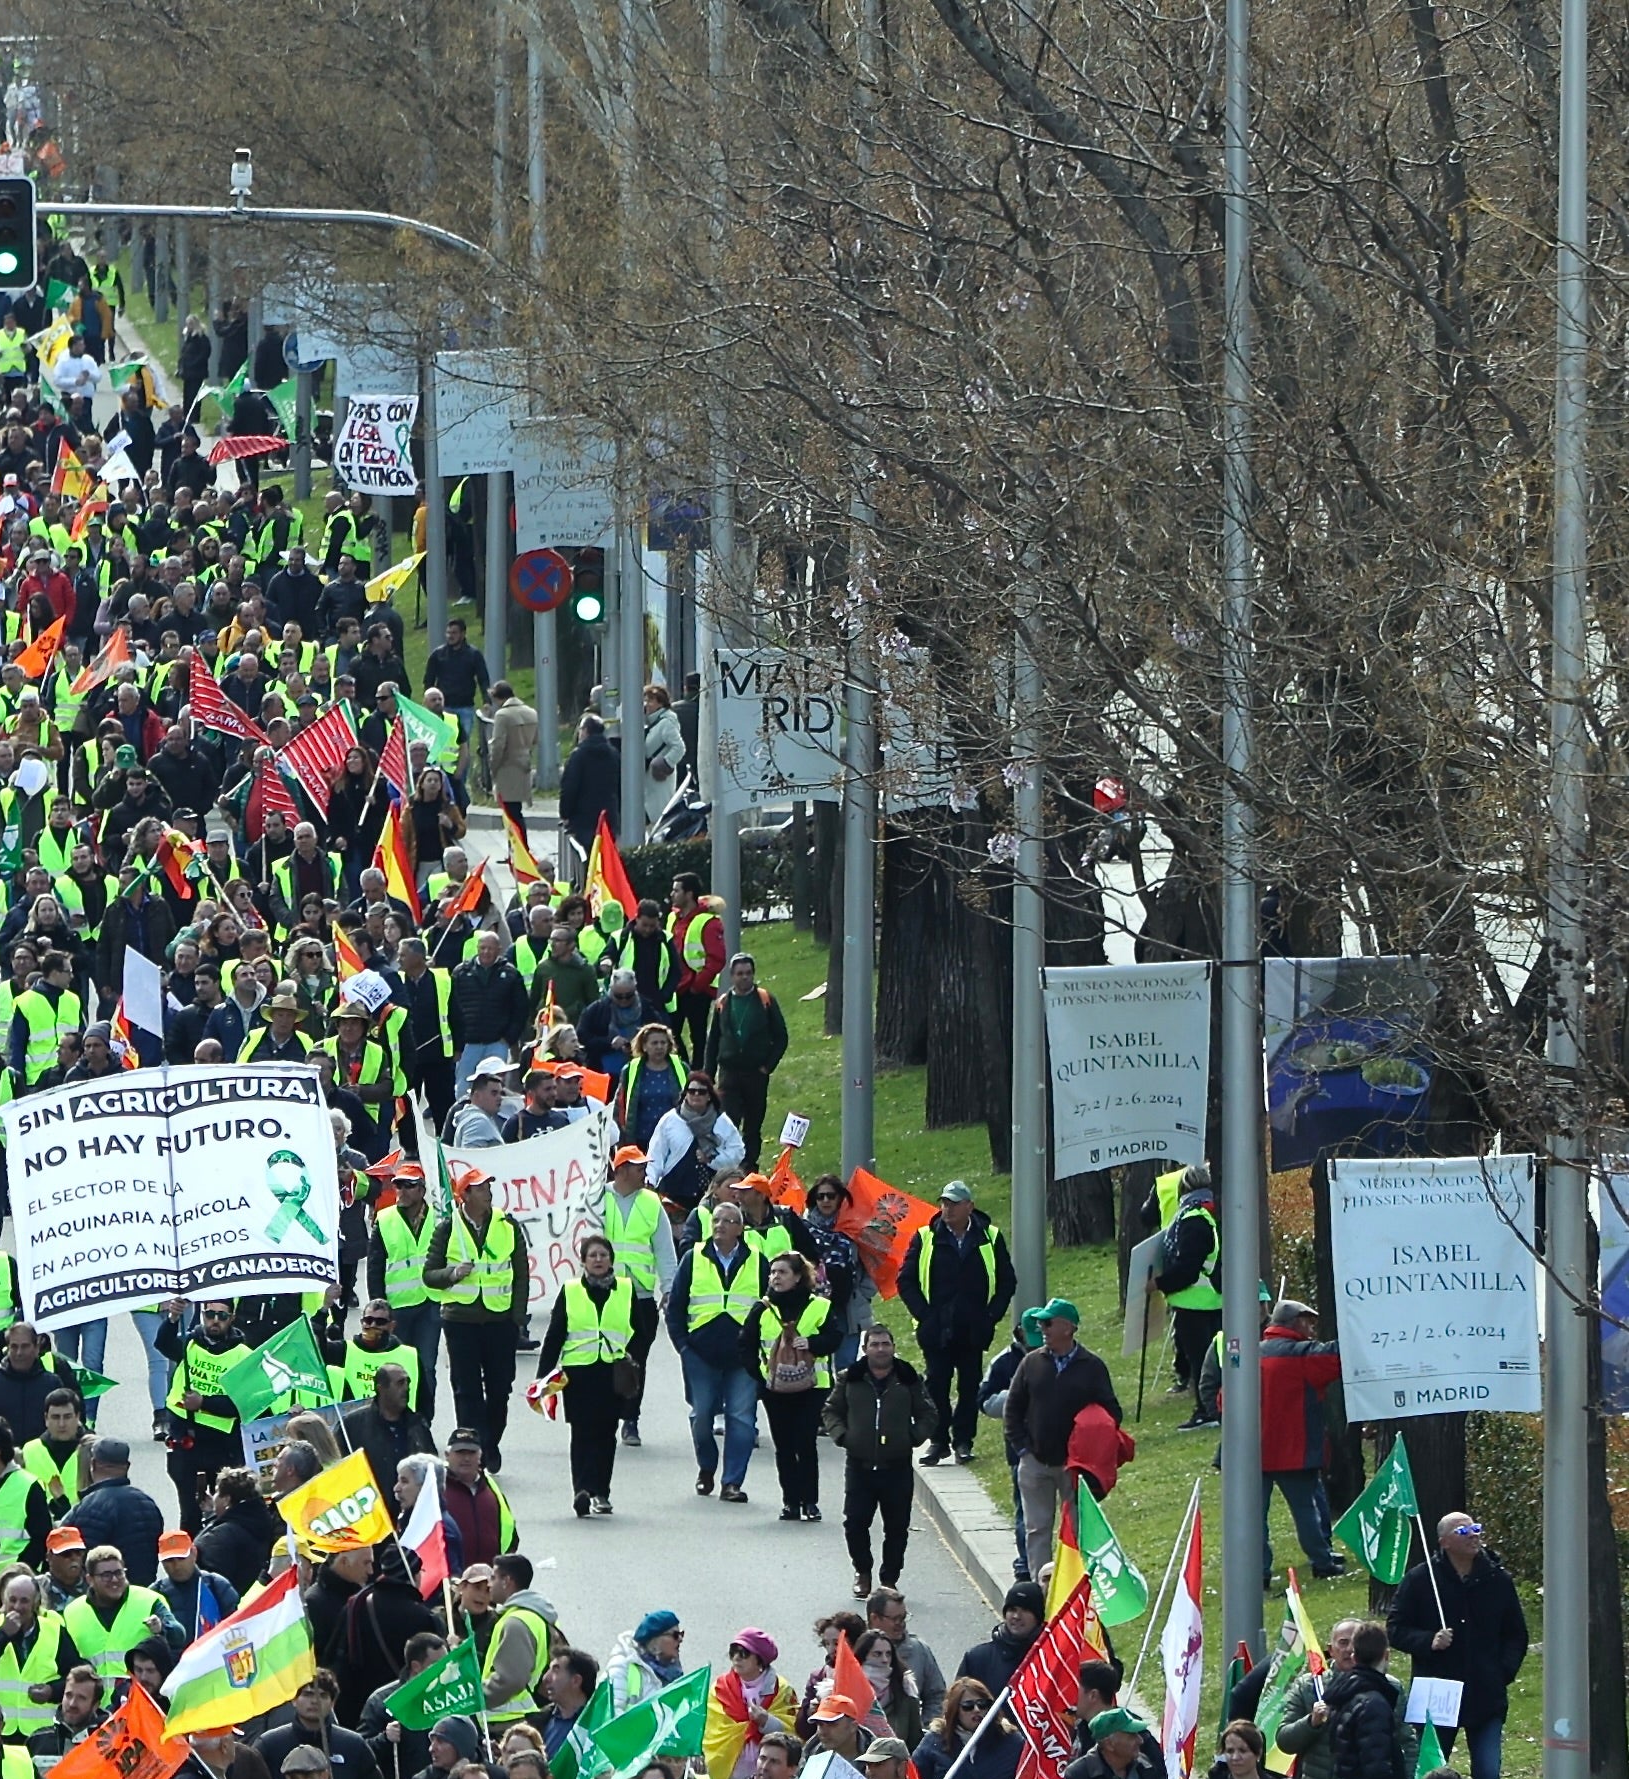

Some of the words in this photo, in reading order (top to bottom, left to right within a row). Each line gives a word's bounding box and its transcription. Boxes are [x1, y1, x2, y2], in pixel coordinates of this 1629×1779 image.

[761, 696, 834, 734] RID
[1062, 980, 1111, 992] MUSEO
[1114, 977, 1188, 990] NACIONAL
[1088, 1031, 1163, 1050] ISABEL
[1056, 1052, 1200, 1083] QUINTANILLA
[17, 1102, 66, 1137] SIN
[73, 1076, 319, 1120] AGRICULTURA,
[23, 1144, 69, 1179] NO
[77, 1133, 146, 1160] HAY
[155, 1116, 293, 1158] FUTURO.
[1108, 1140, 1168, 1159] MADRID
[1358, 1174, 1416, 1191] MUSEO
[1419, 1173, 1509, 1189] NACIONAL
[27, 1199, 48, 1218] EL
[51, 1178, 127, 1208] SECTOR
[132, 1178, 159, 1195] DE
[162, 1181, 185, 1198] LA
[28, 1209, 156, 1249] MAQUINARIA
[158, 1194, 252, 1229] AGRÍCOLA
[31, 1263, 56, 1282] EN
[59, 1242, 130, 1272] APOYO
[133, 1241, 148, 1257] A
[153, 1227, 251, 1259] NUESTROS
[1393, 1244, 1480, 1265] ISABEL
[36, 1271, 191, 1315] AGRICULTORES
[191, 1267, 207, 1286] Y
[209, 1254, 339, 1282] GANADEROS
[1345, 1272, 1527, 1301] QUINTANILLA
[1417, 1385, 1490, 1404] MADRID
